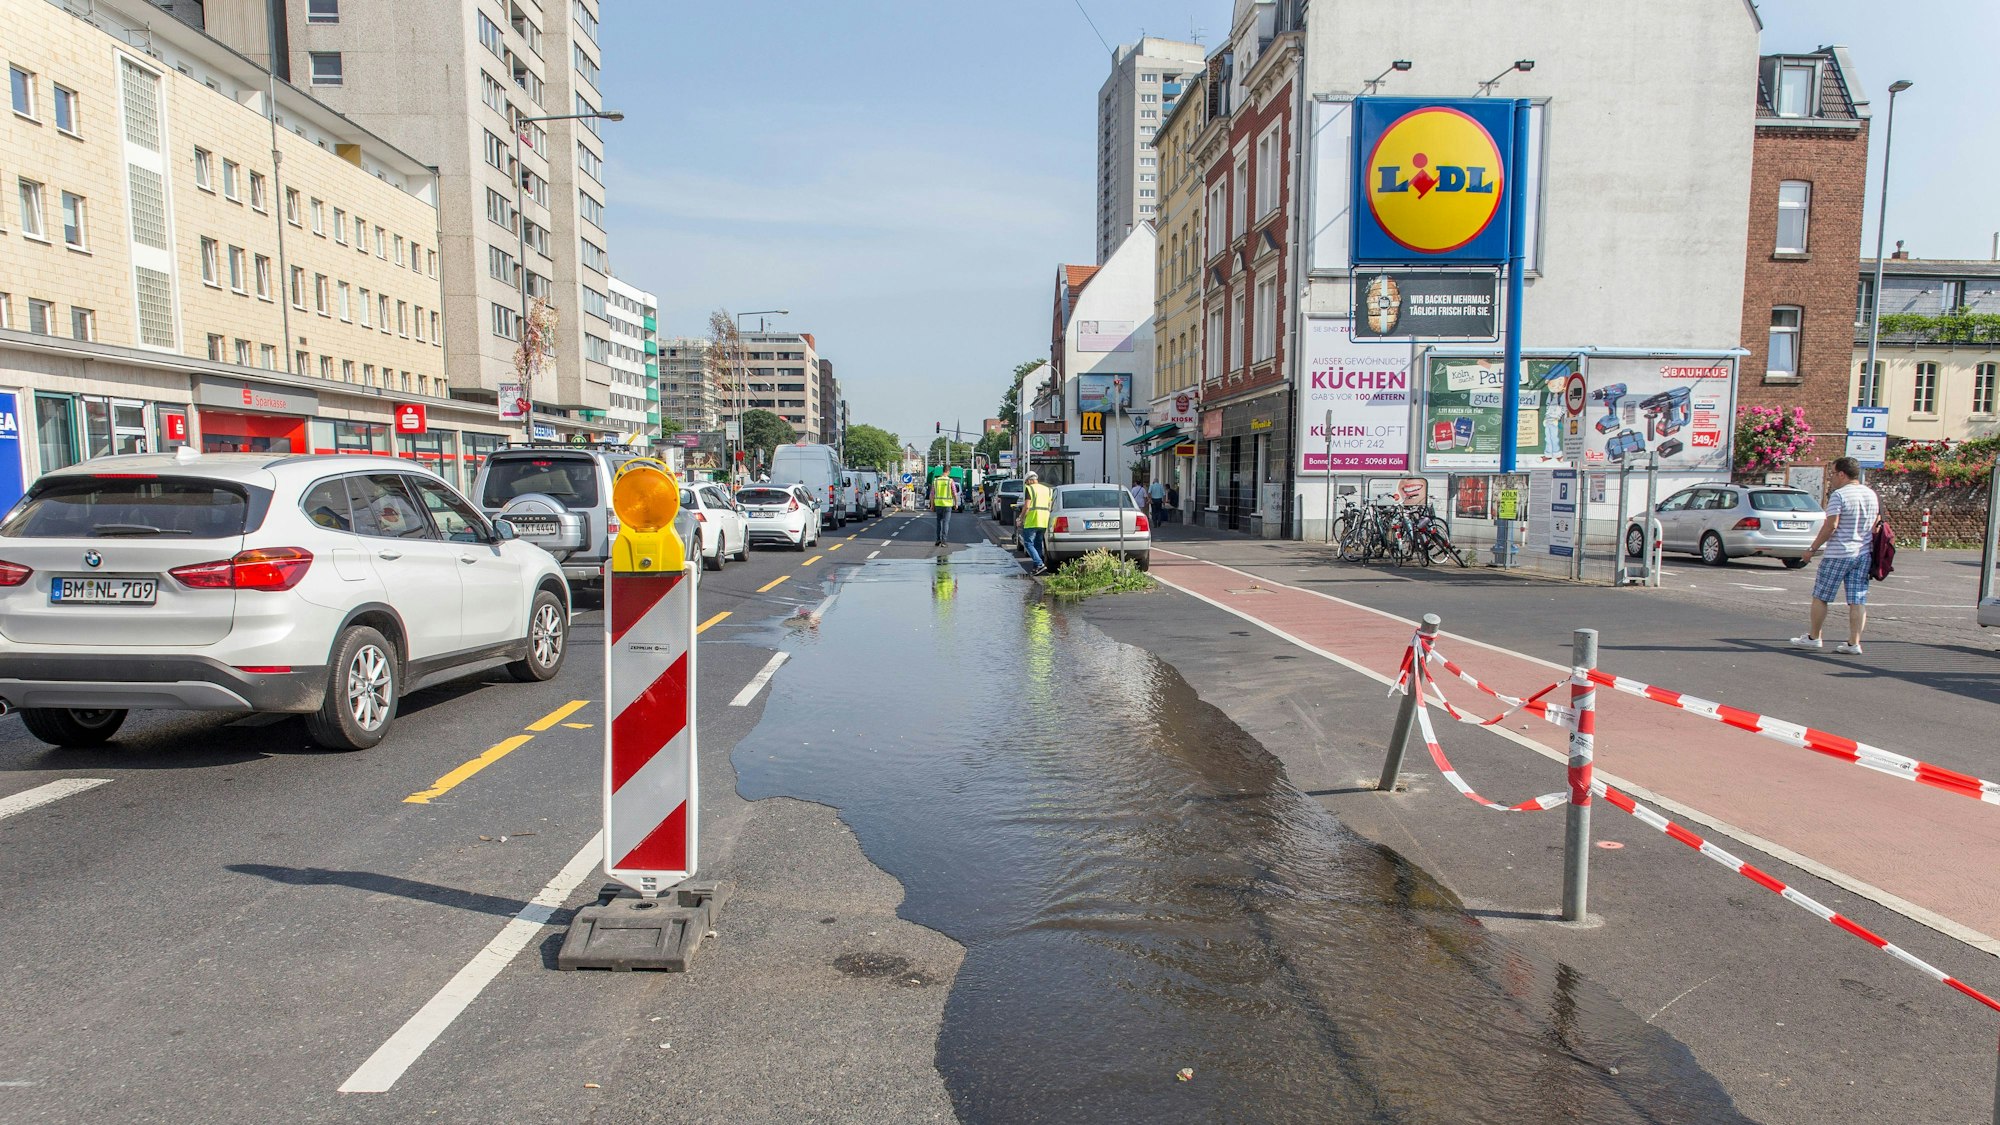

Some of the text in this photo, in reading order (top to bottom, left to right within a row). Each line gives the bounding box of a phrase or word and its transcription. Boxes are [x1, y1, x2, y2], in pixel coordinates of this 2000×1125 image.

[1410, 295, 1490, 304] WIR BACKEN MEHRMALS
[1410, 305, 1490, 315] TÄGLICH FRISCH FÜR SIE.
[1452, 370, 1469, 379] Köln
[1671, 368, 1727, 377] BAUHAUS
[1311, 366, 1406, 389] KÜCHEN
[255, 396, 286, 408] Sparkasse
[1473, 394, 1499, 405] gute
[1343, 440, 1364, 448] HOF
[1367, 440, 1384, 448] 242
[1389, 457, 1403, 465] Köln
[536, 523, 555, 531] 4444
[63, 582, 84, 597] BM
[96, 582, 116, 597] NL
[122, 582, 153, 598] 709
